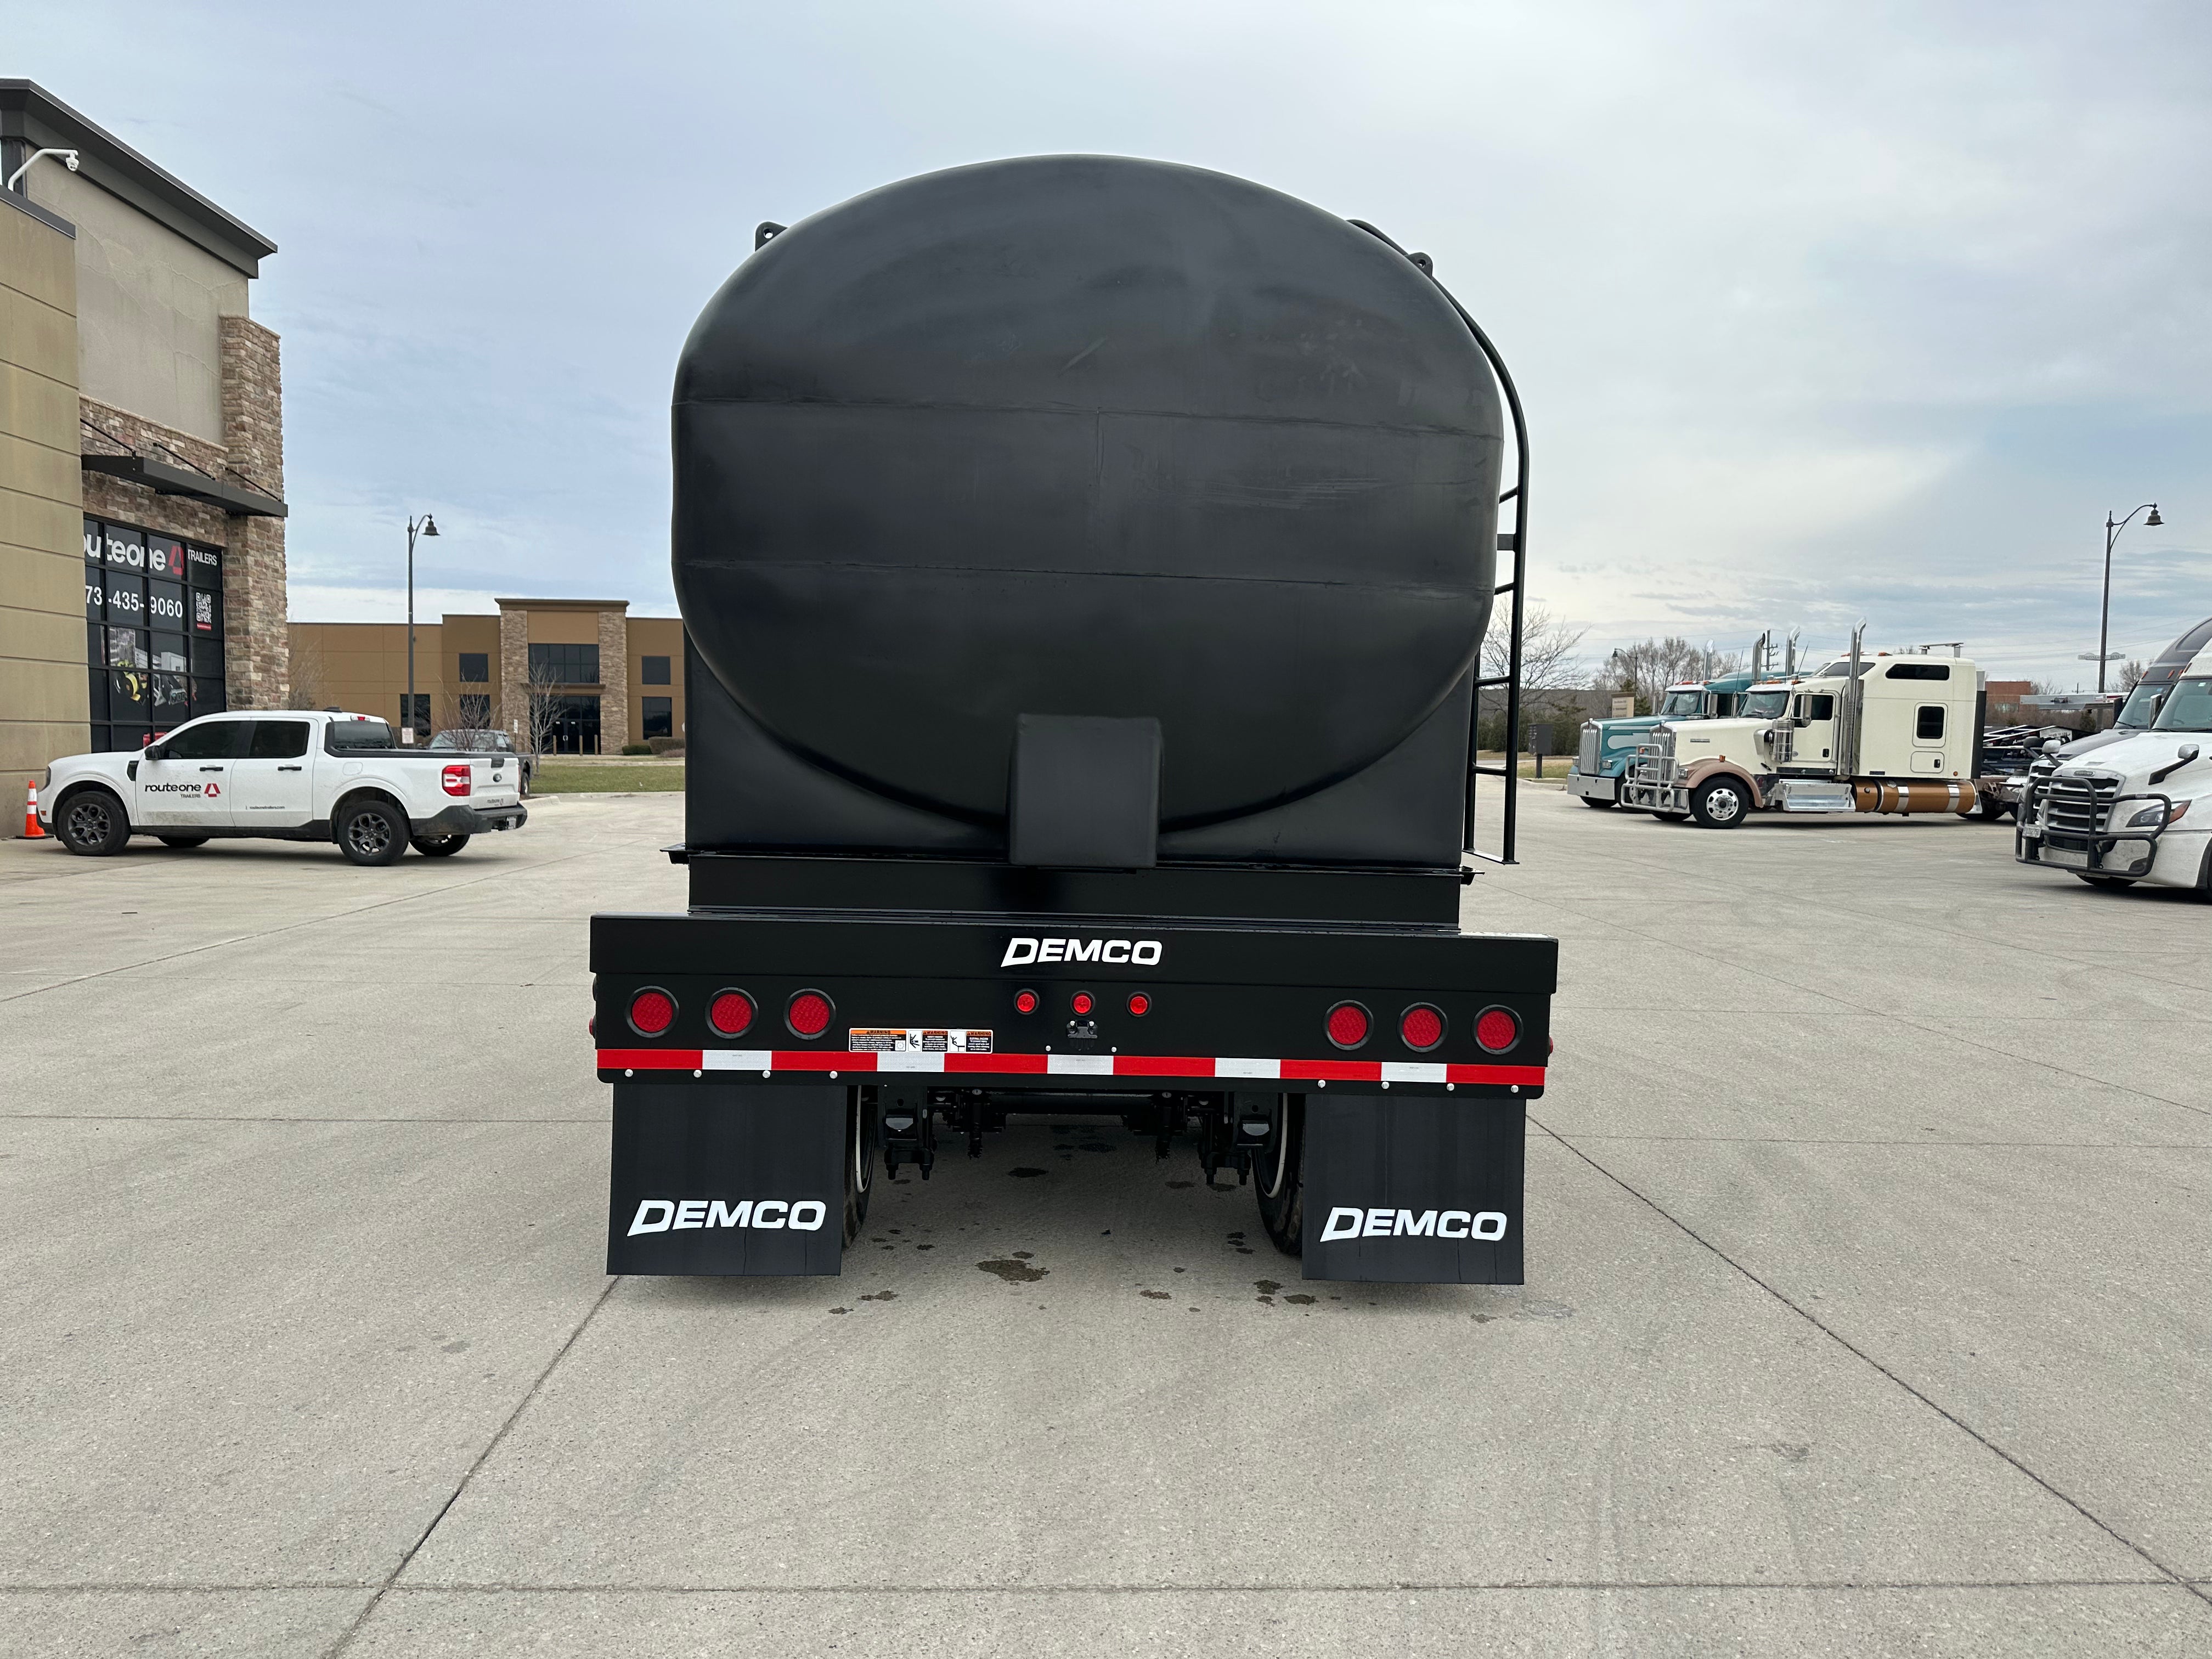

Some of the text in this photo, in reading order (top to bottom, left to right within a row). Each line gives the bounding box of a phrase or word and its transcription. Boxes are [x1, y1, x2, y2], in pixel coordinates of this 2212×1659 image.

[188, 549, 217, 566] TRAILERS
[145, 783, 201, 792] routeone
[1001, 938, 1163, 967] DEMCO
[627, 1200, 826, 1237] DEMCO
[1319, 1207, 1507, 1242] DEMCO
